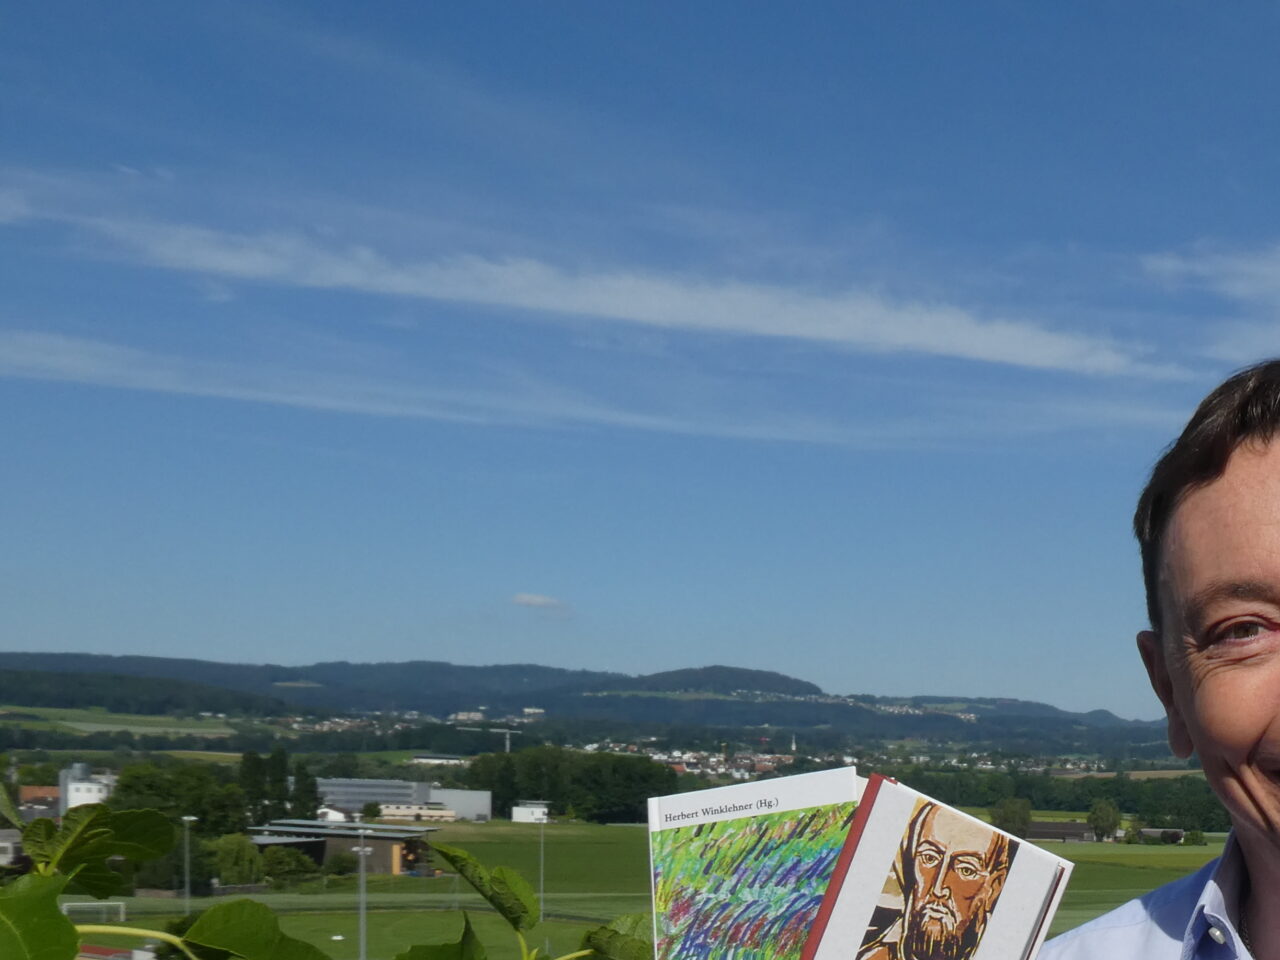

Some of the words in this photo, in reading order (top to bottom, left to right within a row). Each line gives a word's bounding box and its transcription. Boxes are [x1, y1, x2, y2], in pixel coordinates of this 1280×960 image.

[664, 810, 699, 822] Herbert
[701, 802, 753, 817] Winklehner
[756, 797, 779, 810] (Hg.)
